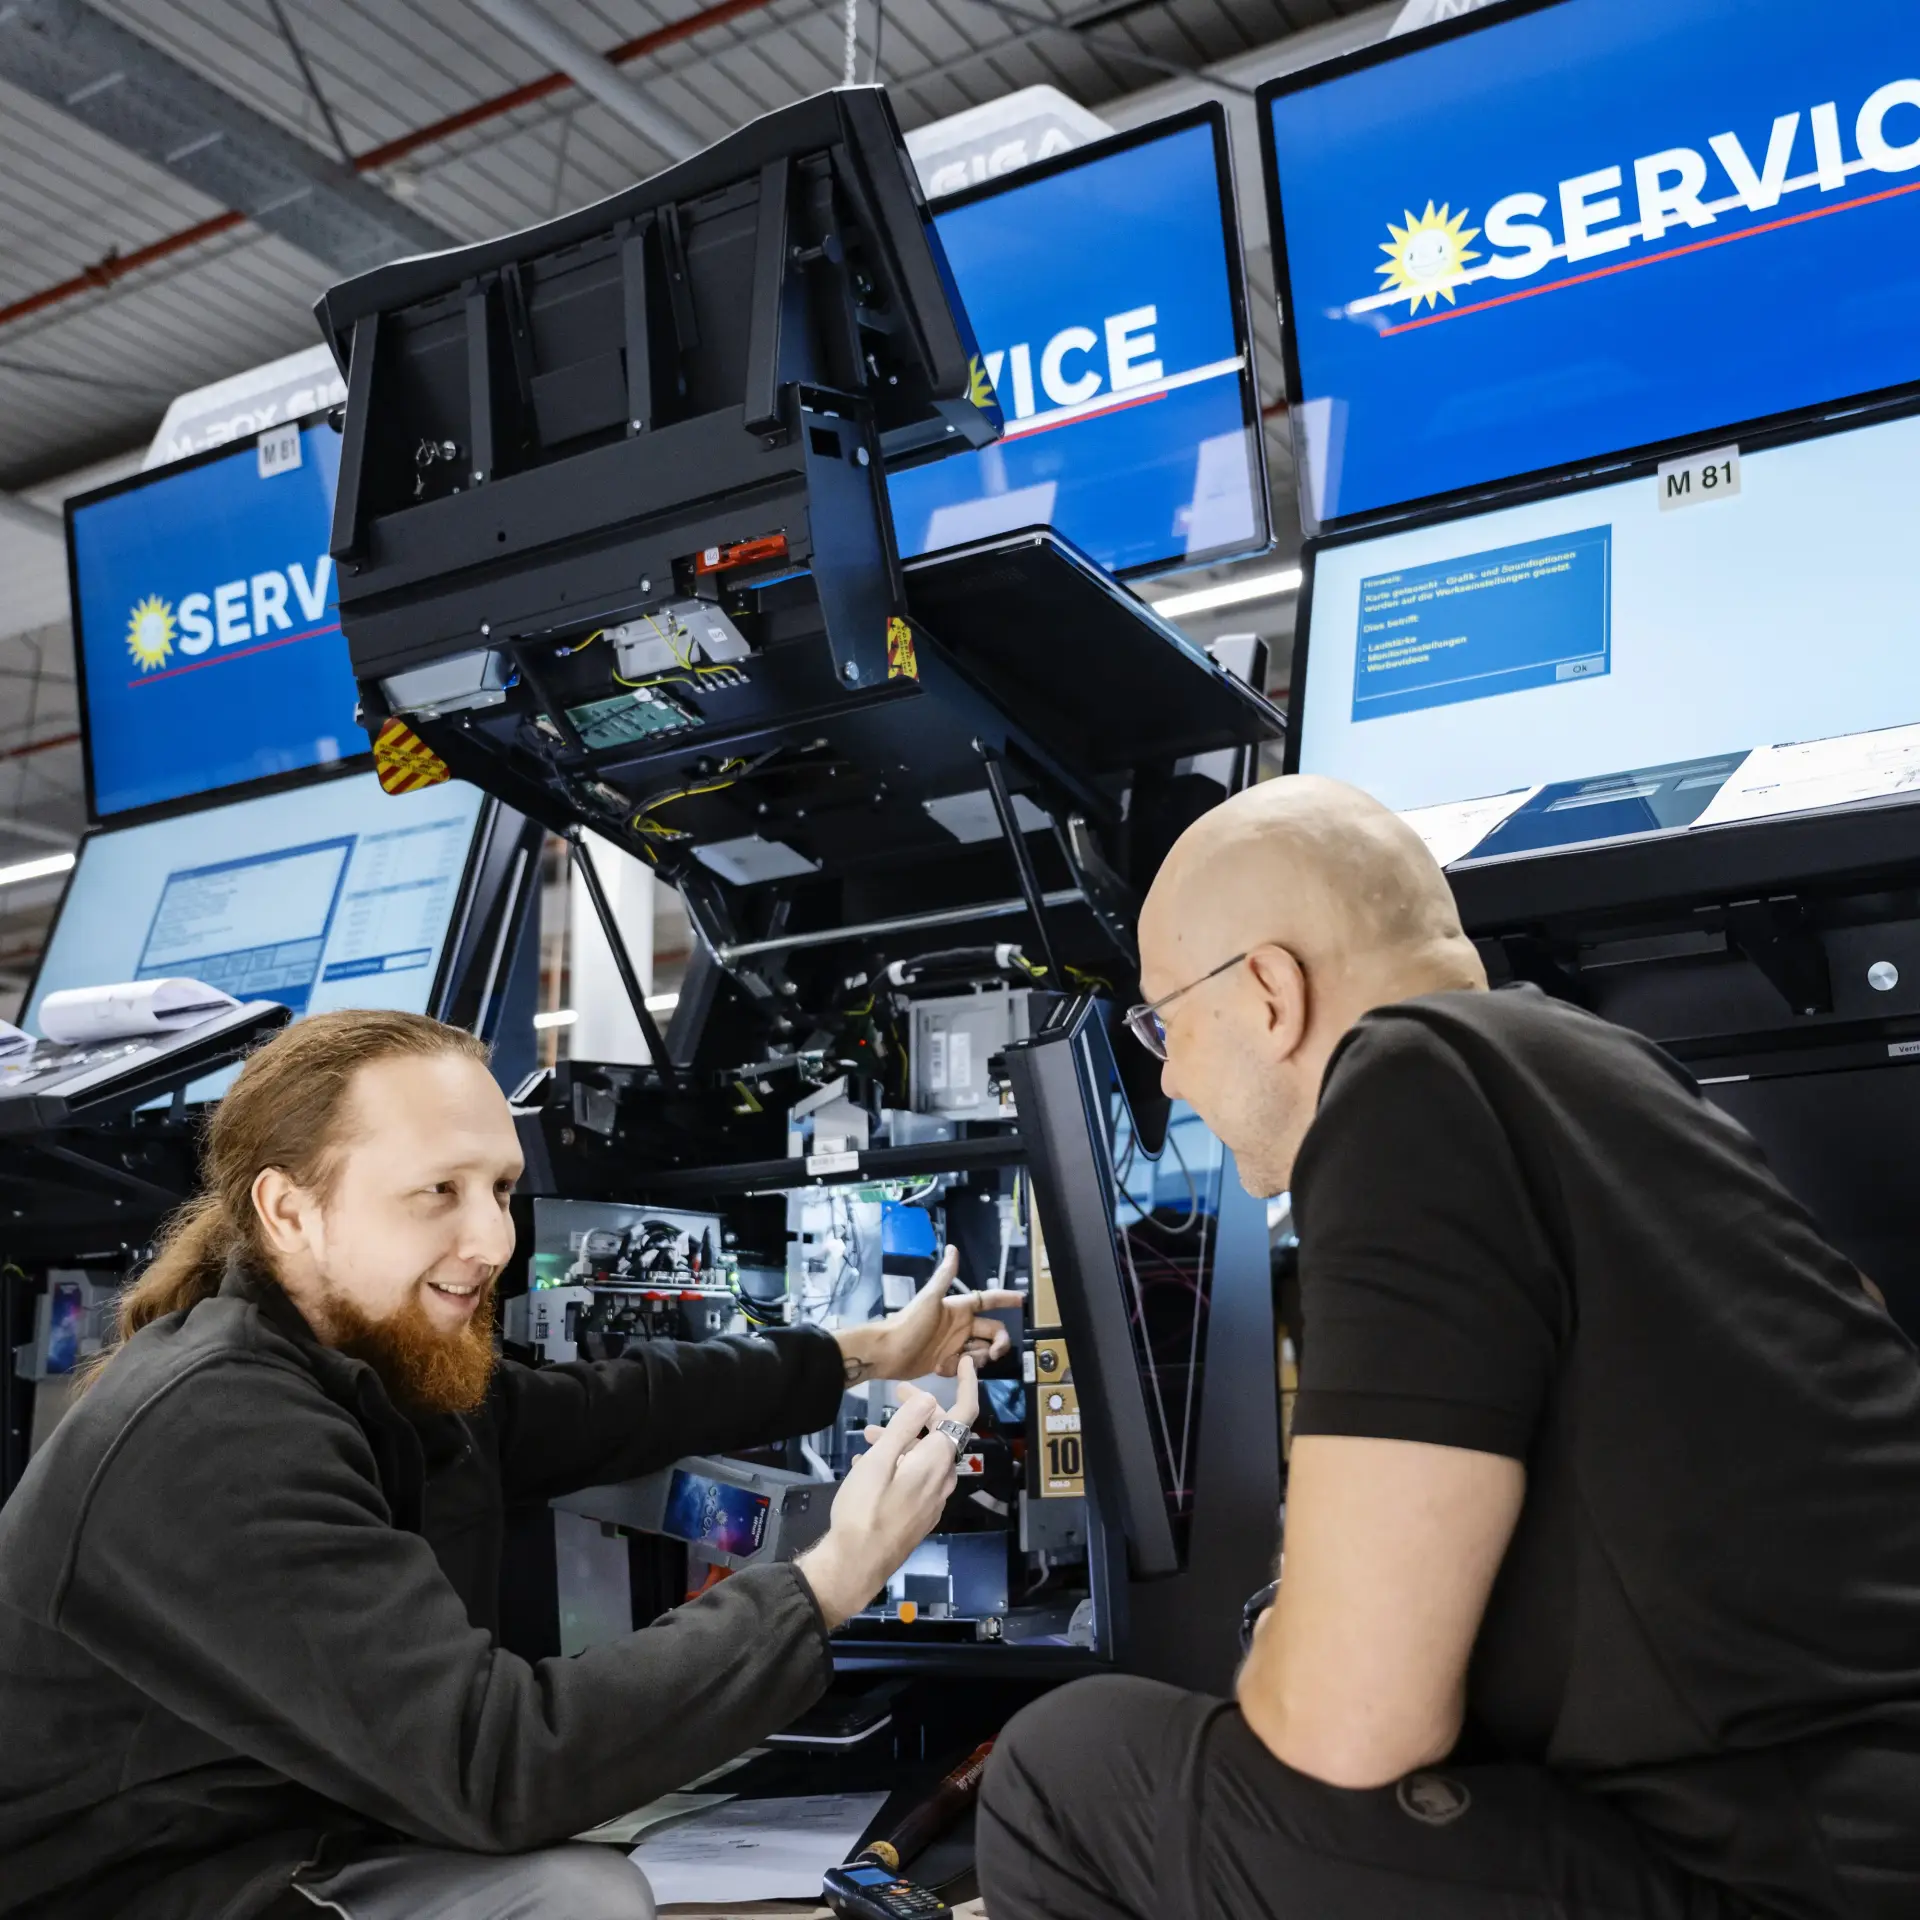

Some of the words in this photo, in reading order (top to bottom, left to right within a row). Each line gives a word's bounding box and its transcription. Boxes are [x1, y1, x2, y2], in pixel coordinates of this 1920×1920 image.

[1667, 470, 1690, 498] M
[1702, 460, 1731, 489] 81
[1364, 599, 1399, 614] wurden
[1401, 594, 1417, 607] auf
[1417, 591, 1434, 604] die
[1435, 569, 1530, 599] Werkseinstellungen
[1365, 590, 1390, 603] Karte
[1480, 566, 1500, 579] und
[1501, 551, 1576, 575] Soundoptionen
[178, 554, 333, 655] SERV
[1572, 663, 1588, 674] Ok
[1046, 1436, 1080, 1475] 10
